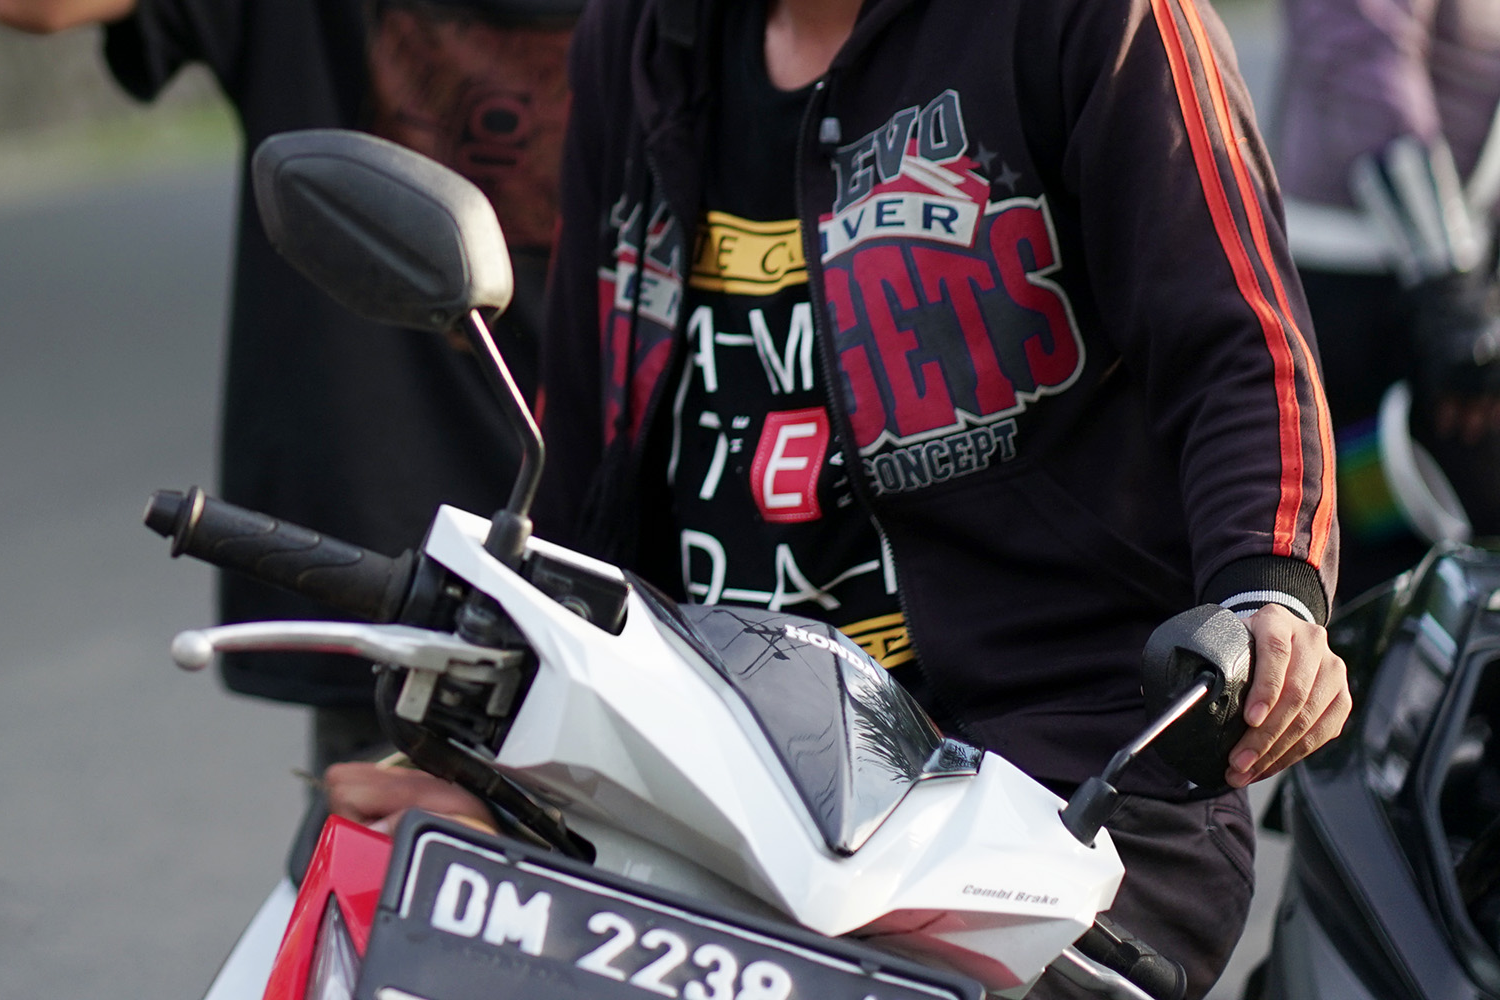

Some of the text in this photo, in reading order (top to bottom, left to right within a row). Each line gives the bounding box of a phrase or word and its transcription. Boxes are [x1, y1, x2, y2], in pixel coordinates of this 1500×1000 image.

[431, 862, 552, 957] DM
[962, 884, 1060, 906] Combi Brake
